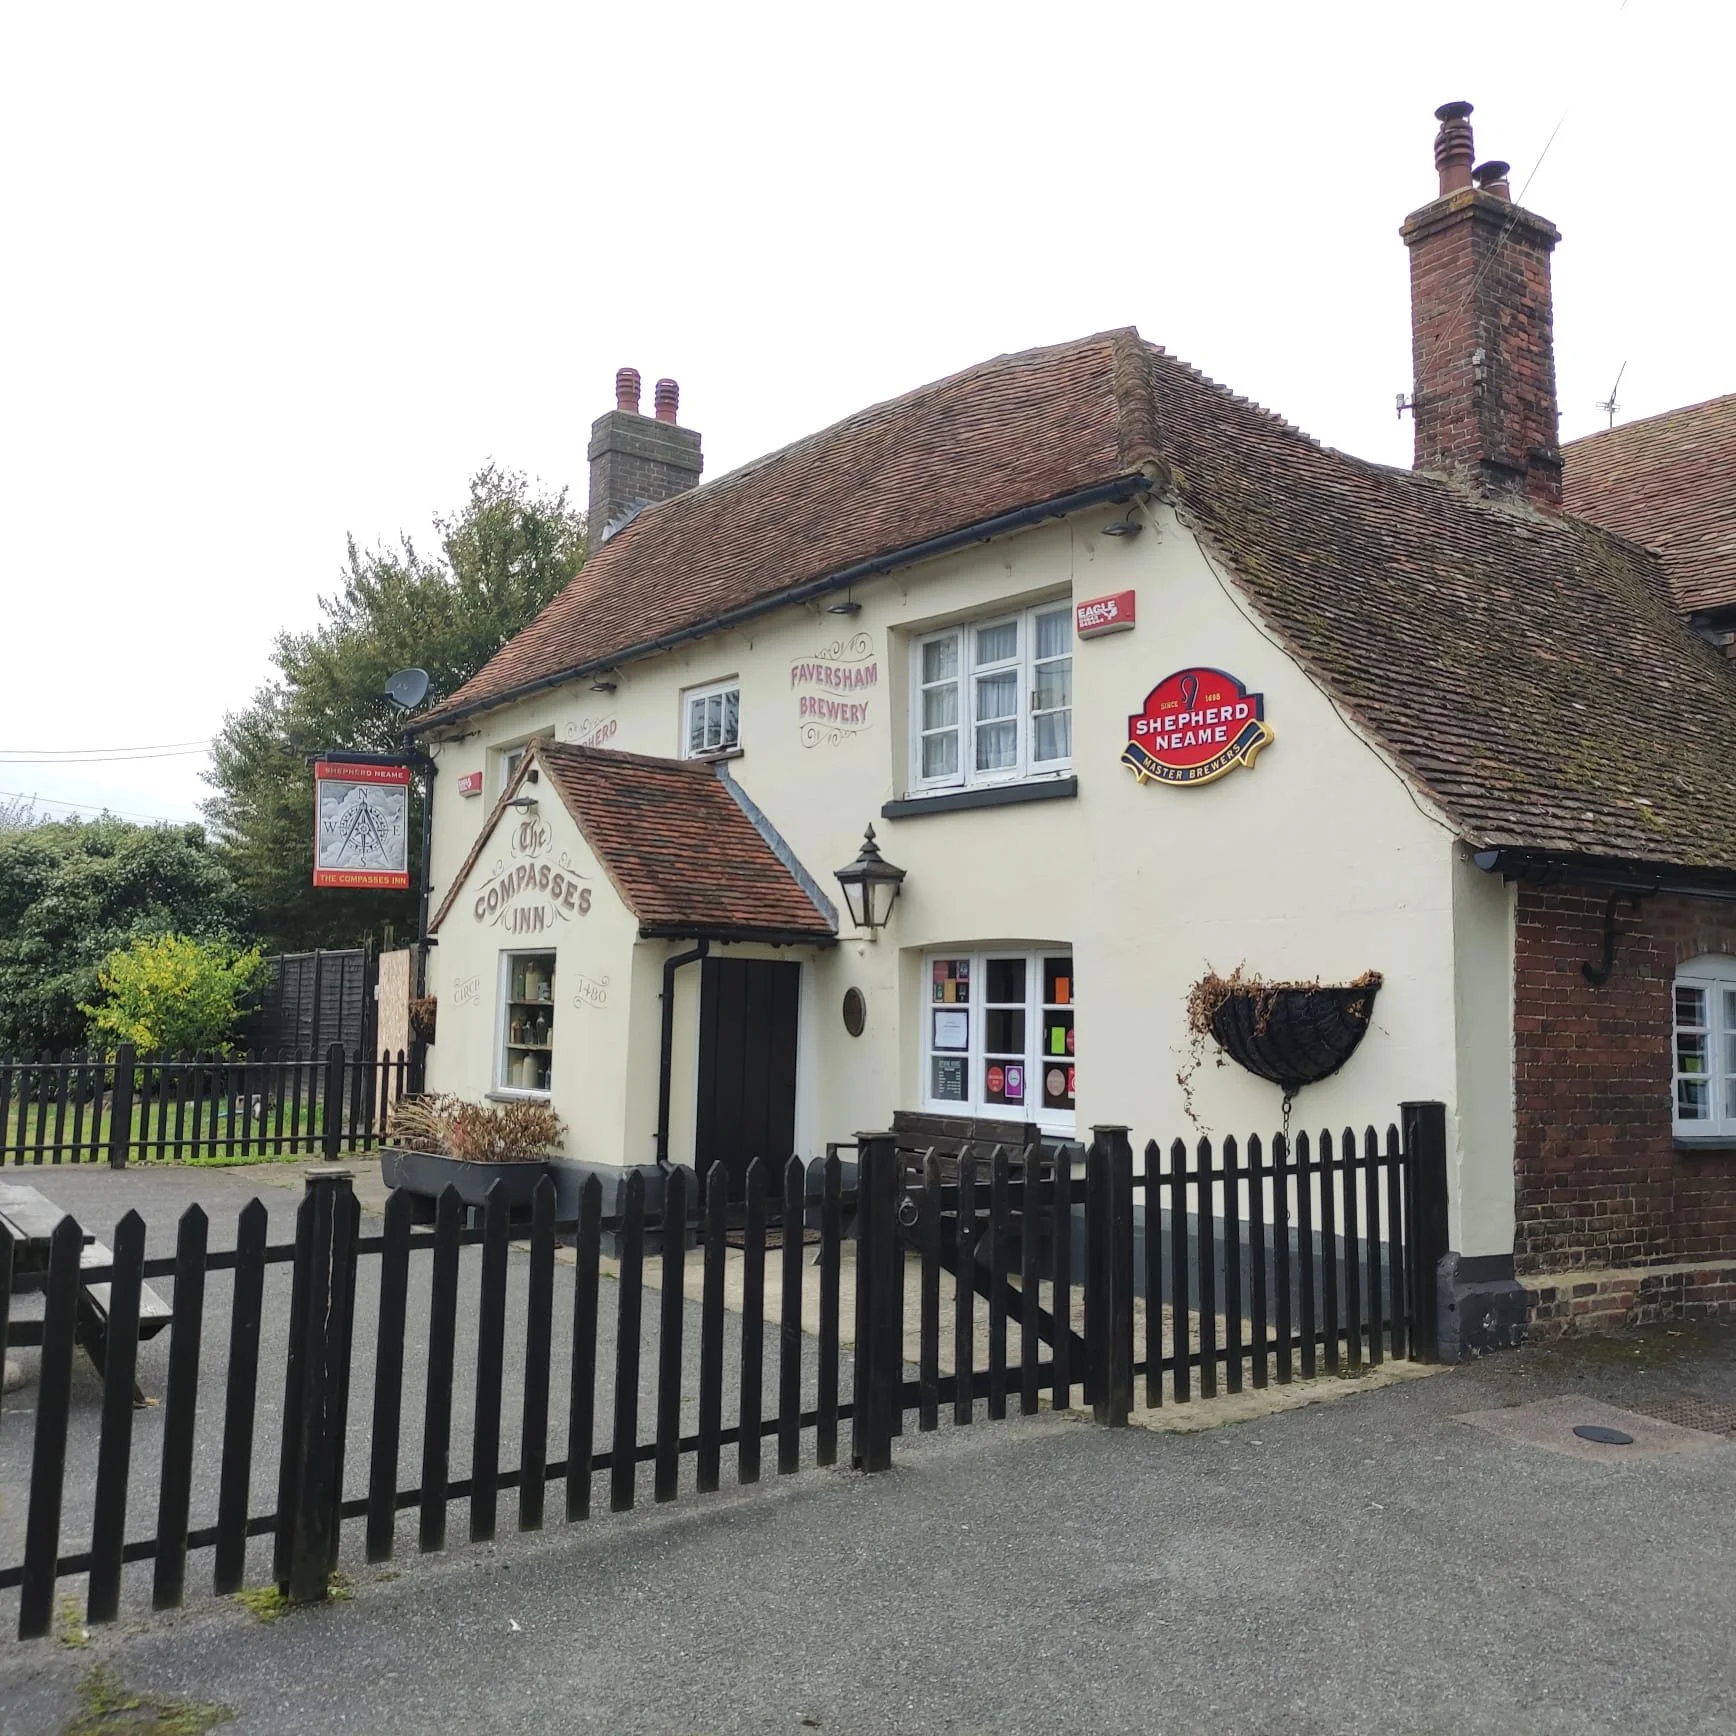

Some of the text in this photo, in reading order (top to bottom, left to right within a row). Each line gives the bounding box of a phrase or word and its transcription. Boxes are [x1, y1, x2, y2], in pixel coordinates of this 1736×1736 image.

[1078, 600, 1117, 619] EAGLE
[791, 662, 878, 690] FAVERSHAM
[800, 696, 869, 724] BREWERY
[1136, 703, 1249, 735] SHEPHERD
[1156, 726, 1228, 751] NEAME
[325, 767, 404, 779] SHEPHERD NEAME
[1142, 743, 1241, 780] MASTER BREWERS
[358, 788, 369, 800] N
[323, 821, 338, 833] W
[518, 818, 547, 856] The
[321, 874, 407, 885] THE COMPASSES INN
[474, 863, 593, 923] COMPASSES
[512, 906, 546, 935] INN
[578, 979, 607, 1003] 1480
